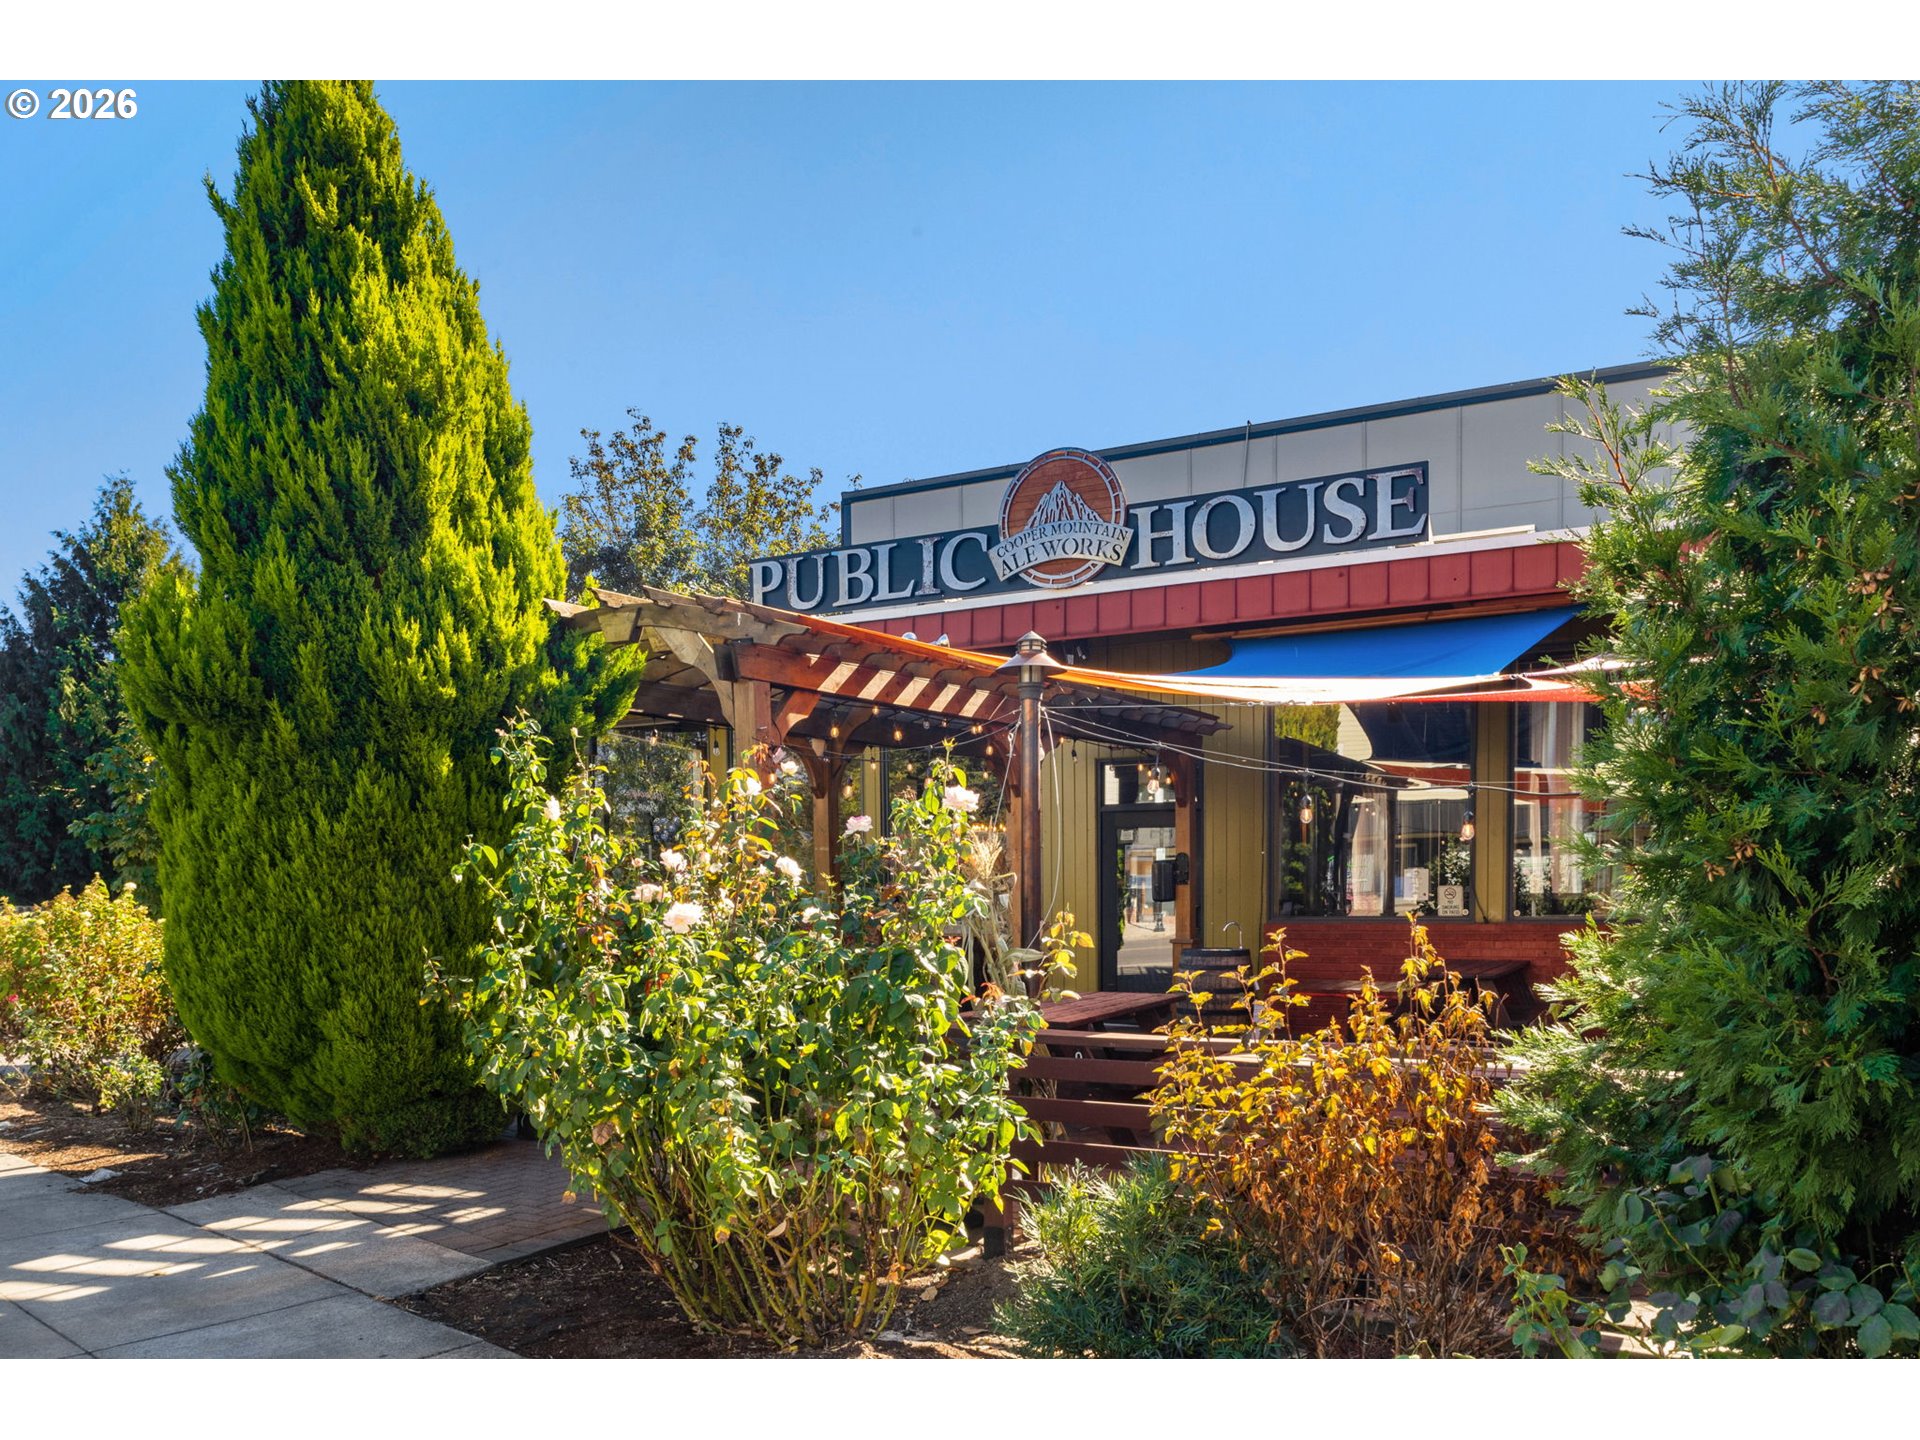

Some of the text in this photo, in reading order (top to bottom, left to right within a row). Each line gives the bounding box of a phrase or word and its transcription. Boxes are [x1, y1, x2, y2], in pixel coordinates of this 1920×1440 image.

[749, 467, 1428, 611] PUBLIC HOUSE
[997, 521, 1129, 558] COOPER MOUNTAIN
[1001, 537, 1123, 577] ALE WORKS
